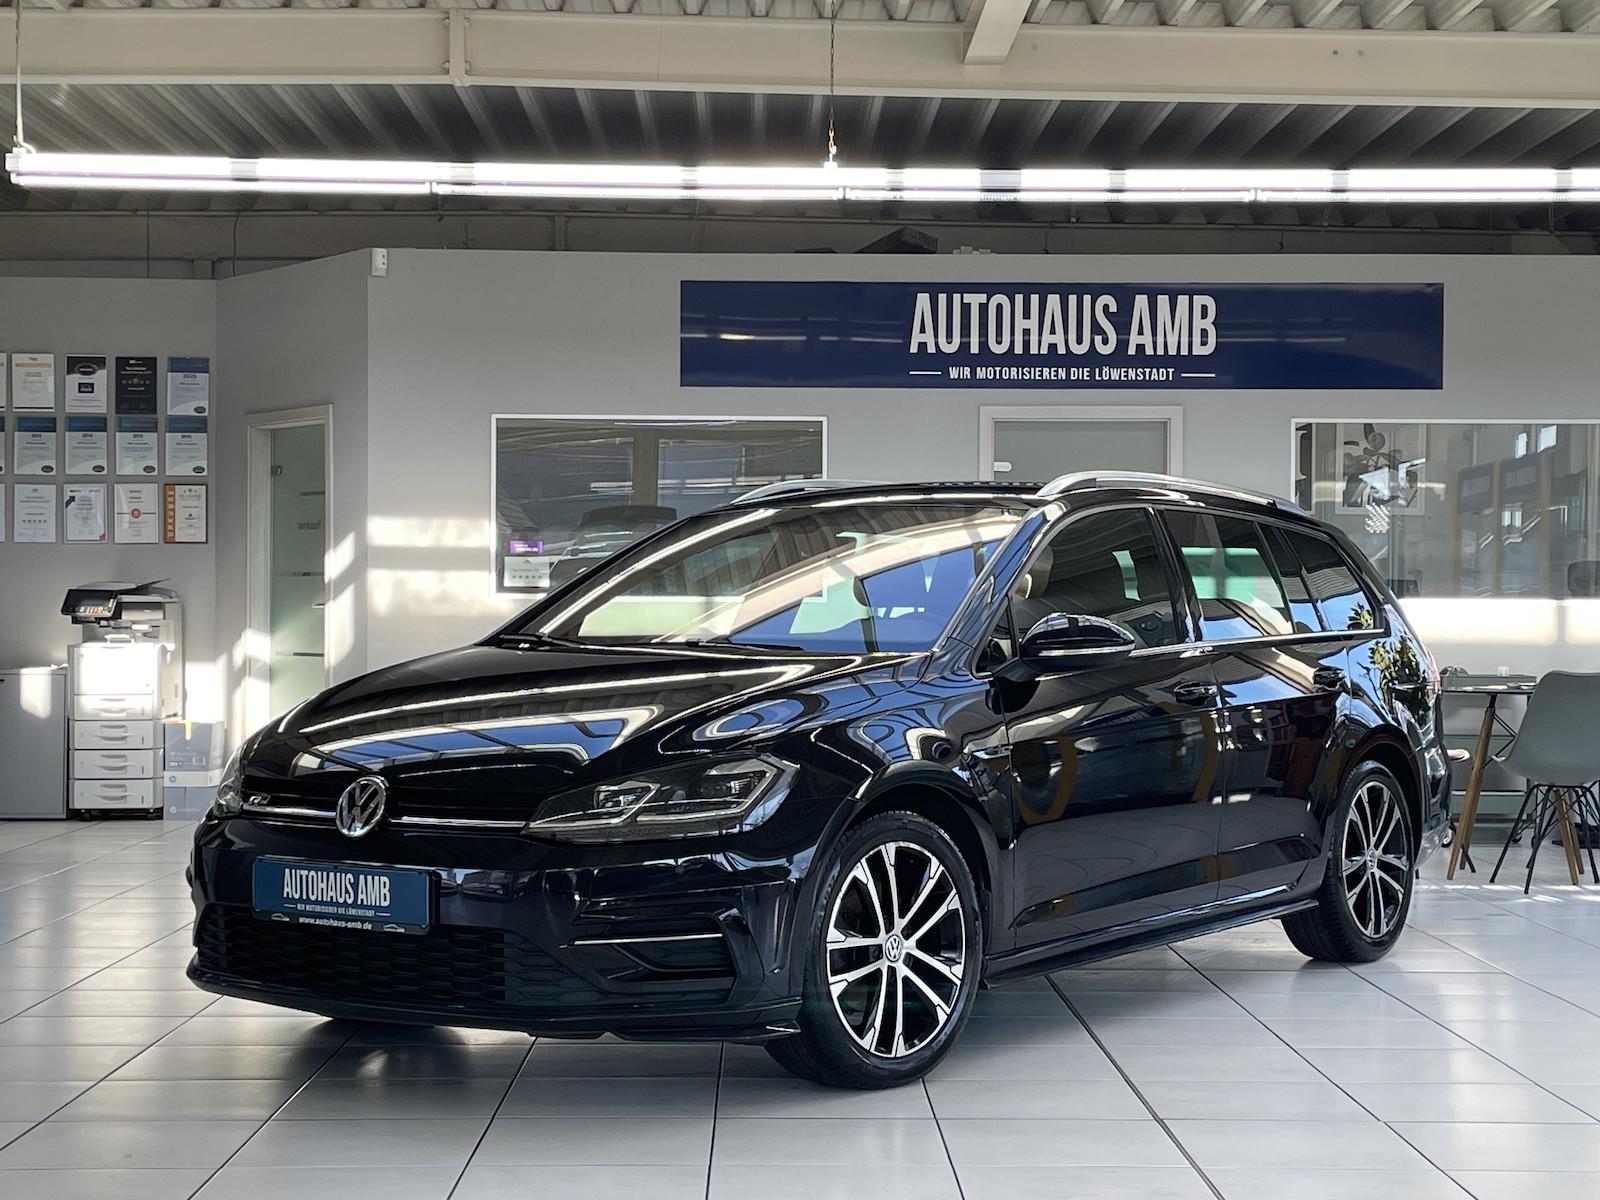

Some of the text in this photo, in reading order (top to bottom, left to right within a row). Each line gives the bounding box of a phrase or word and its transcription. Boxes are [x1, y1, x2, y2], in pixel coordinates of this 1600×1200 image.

[909, 293, 1217, 356] AUTOHAUS AMB
[949, 365, 1175, 381] WIR MOTORISIEREN DIE LÖWENSTADT
[283, 868, 391, 907] AUTOHAUS AMB
[299, 916, 373, 930] www.autohaus-amb.de
